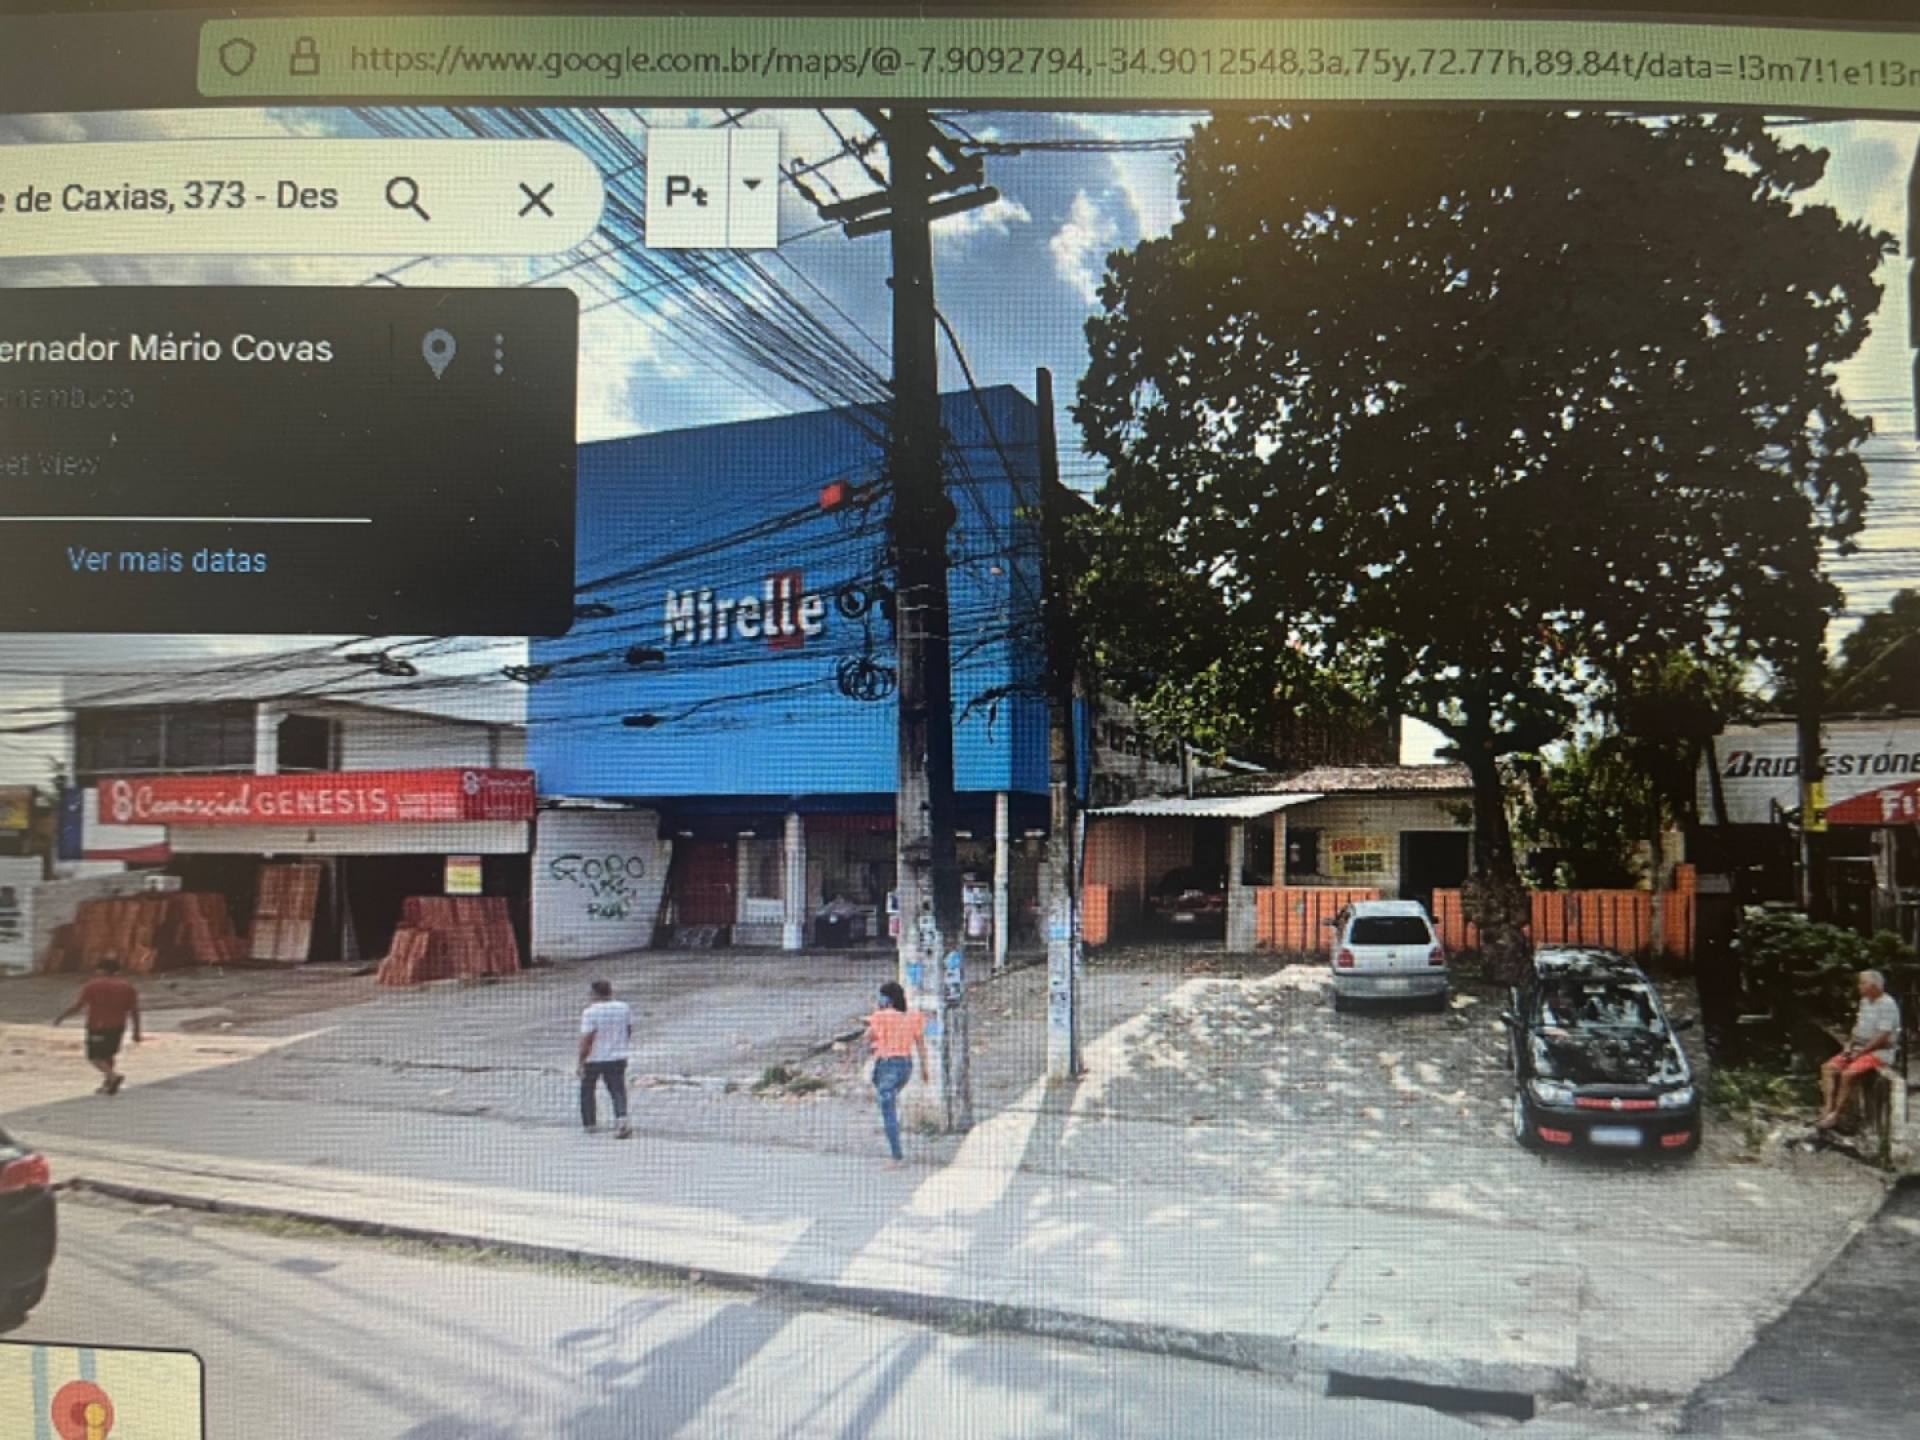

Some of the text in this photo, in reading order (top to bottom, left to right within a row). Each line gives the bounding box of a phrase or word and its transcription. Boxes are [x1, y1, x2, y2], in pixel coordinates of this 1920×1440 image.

[15, 185, 52, 213] de
[61, 183, 175, 214] Caxias,
[183, 180, 246, 210] 373
[276, 180, 339, 210] Des
[665, 174, 708, 207] Pt
[129, 331, 221, 362] Mário
[231, 333, 335, 363] Covas
[66, 547, 268, 573] Ver mais datas
[664, 577, 825, 644] Mirelle
[256, 786, 390, 816] GENESIS
